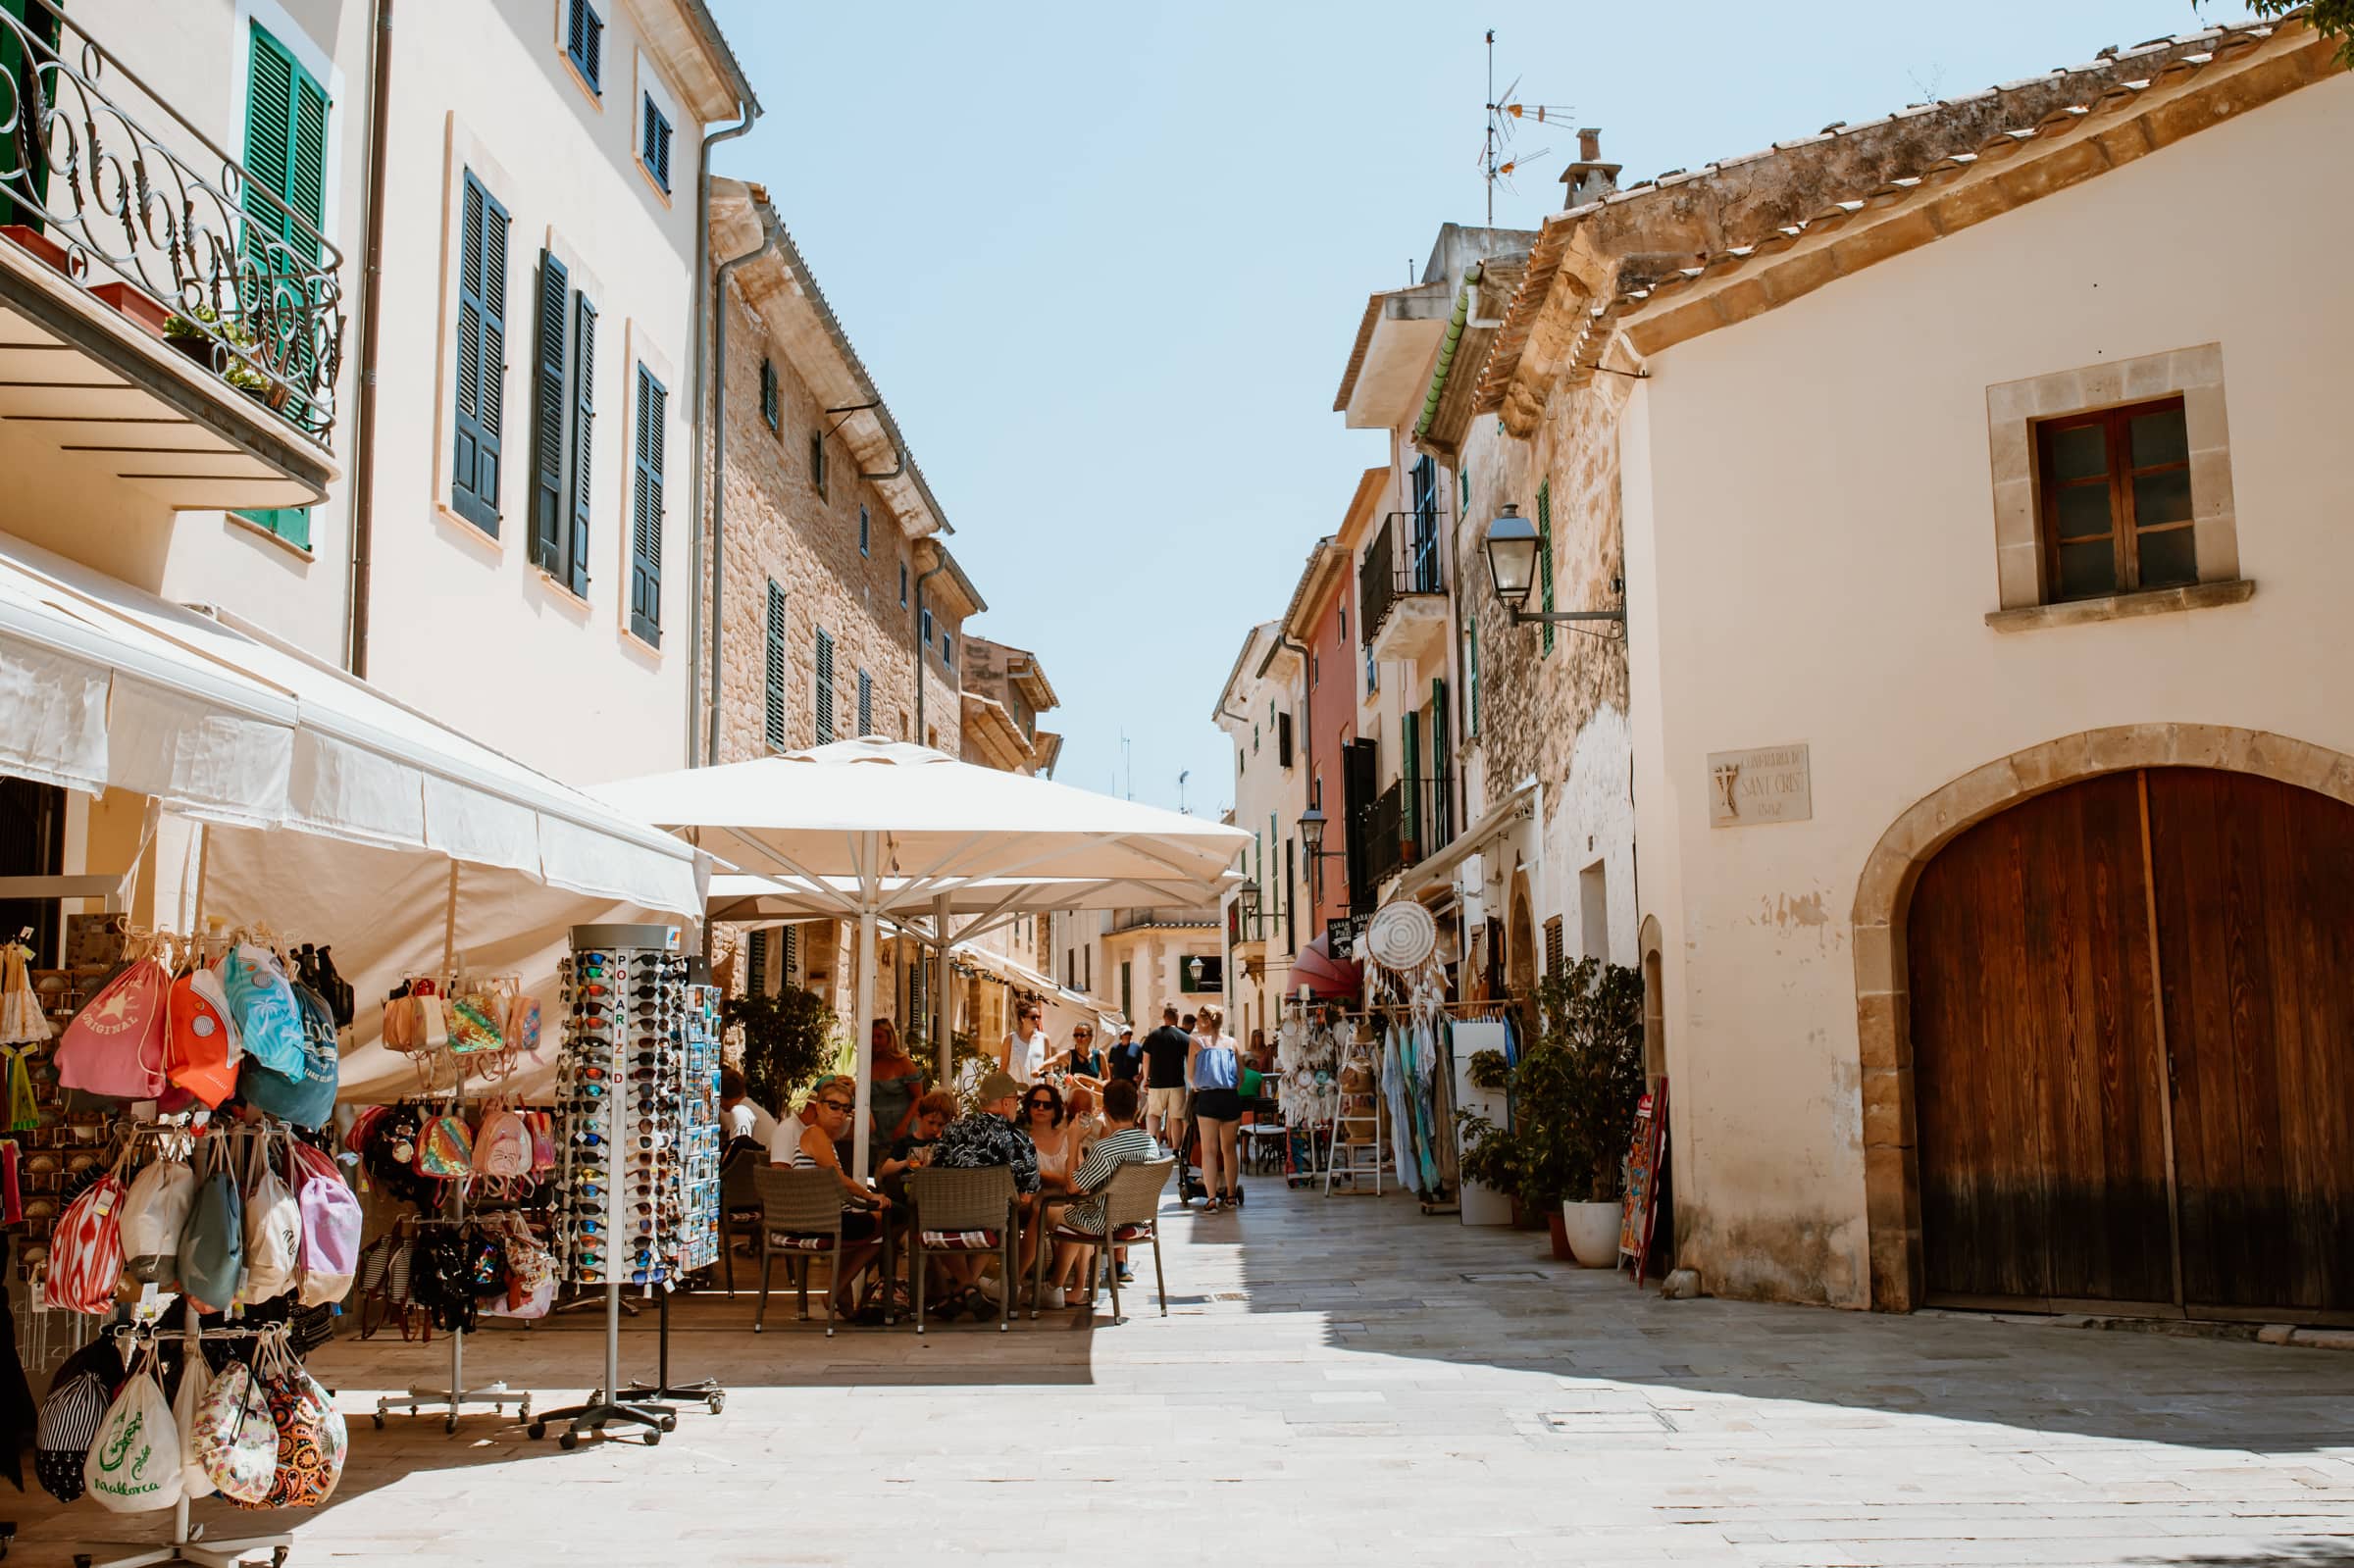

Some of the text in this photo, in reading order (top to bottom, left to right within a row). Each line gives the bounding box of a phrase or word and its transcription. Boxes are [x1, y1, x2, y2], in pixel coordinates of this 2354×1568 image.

[1741, 771, 1805, 796] SANT CRIST
[614, 955, 627, 1084] POLARIZED
[94, 1478, 161, 1495] Mallorca
